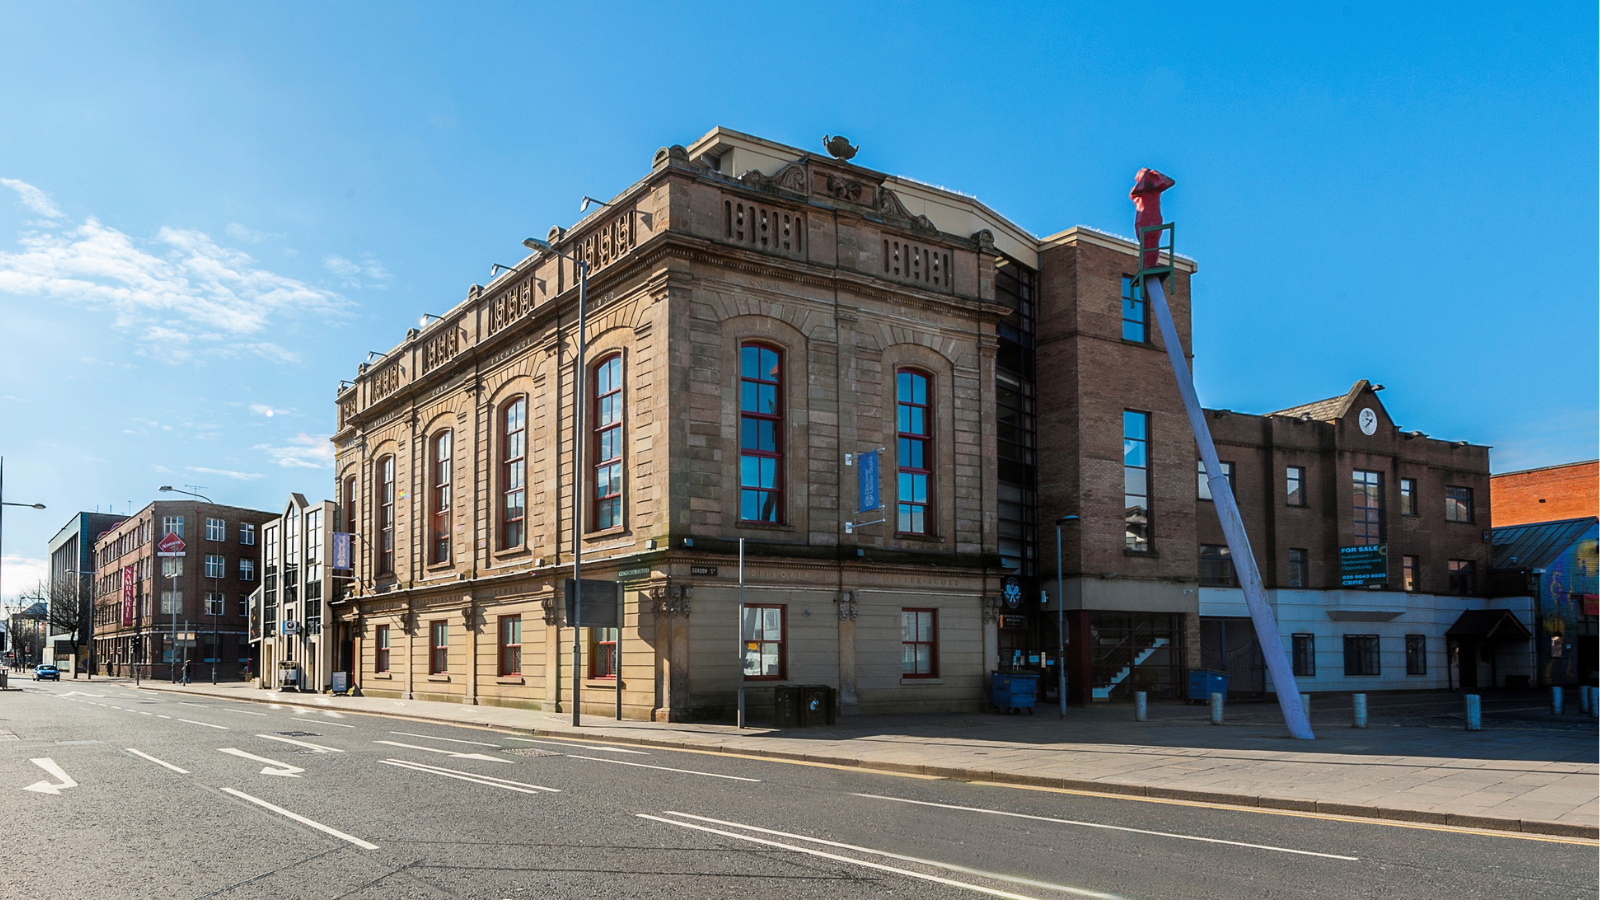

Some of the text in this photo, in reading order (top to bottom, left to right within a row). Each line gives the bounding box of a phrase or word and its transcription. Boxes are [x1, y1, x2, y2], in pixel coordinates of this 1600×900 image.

[432, 384, 448, 396] CORN
[491, 338, 531, 365] EXCHANGE
[592, 292, 615, 309] 1852
[750, 569, 960, 586] DISCOVER ULSTER-SCOTS
